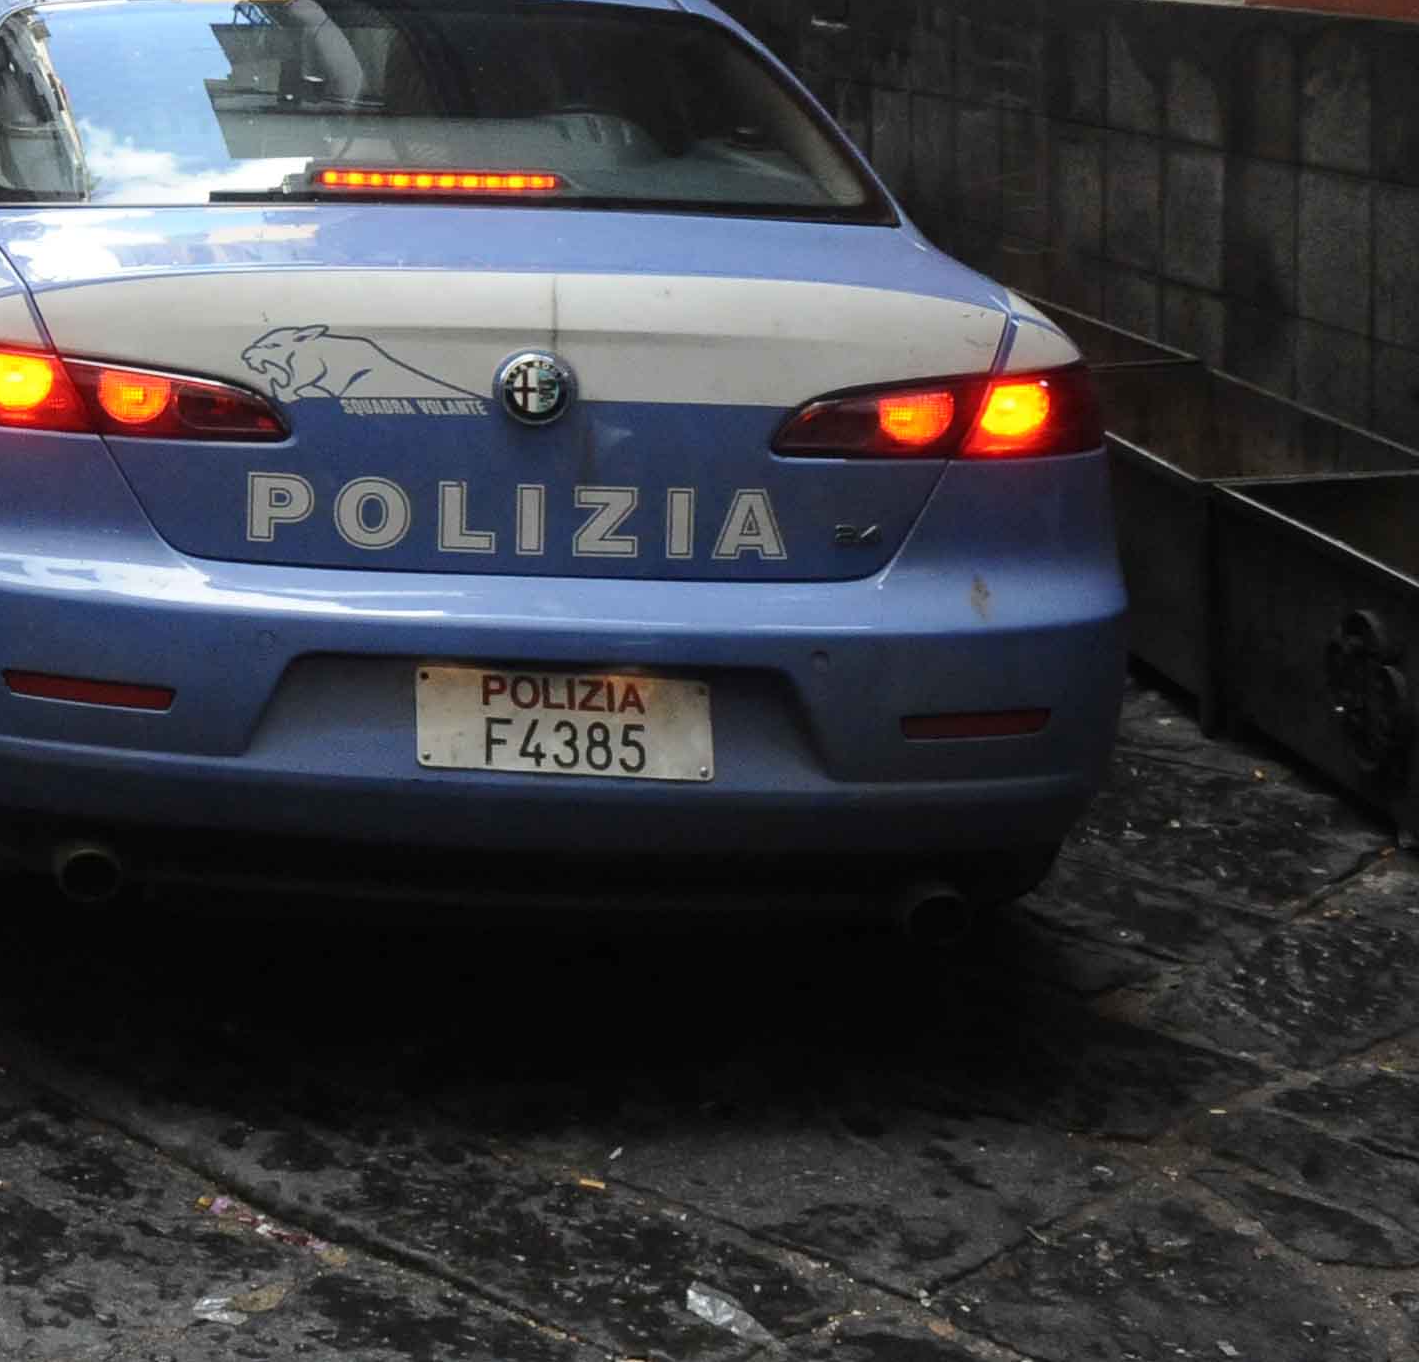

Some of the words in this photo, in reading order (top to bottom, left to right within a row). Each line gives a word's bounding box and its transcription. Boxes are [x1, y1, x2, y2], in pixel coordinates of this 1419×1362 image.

[339, 398, 416, 416] SQUADRA
[415, 399, 488, 416] VOLANTE
[247, 472, 787, 560] POLIZIA
[481, 674, 645, 714] POLIZIA
[485, 717, 646, 773] F4385
